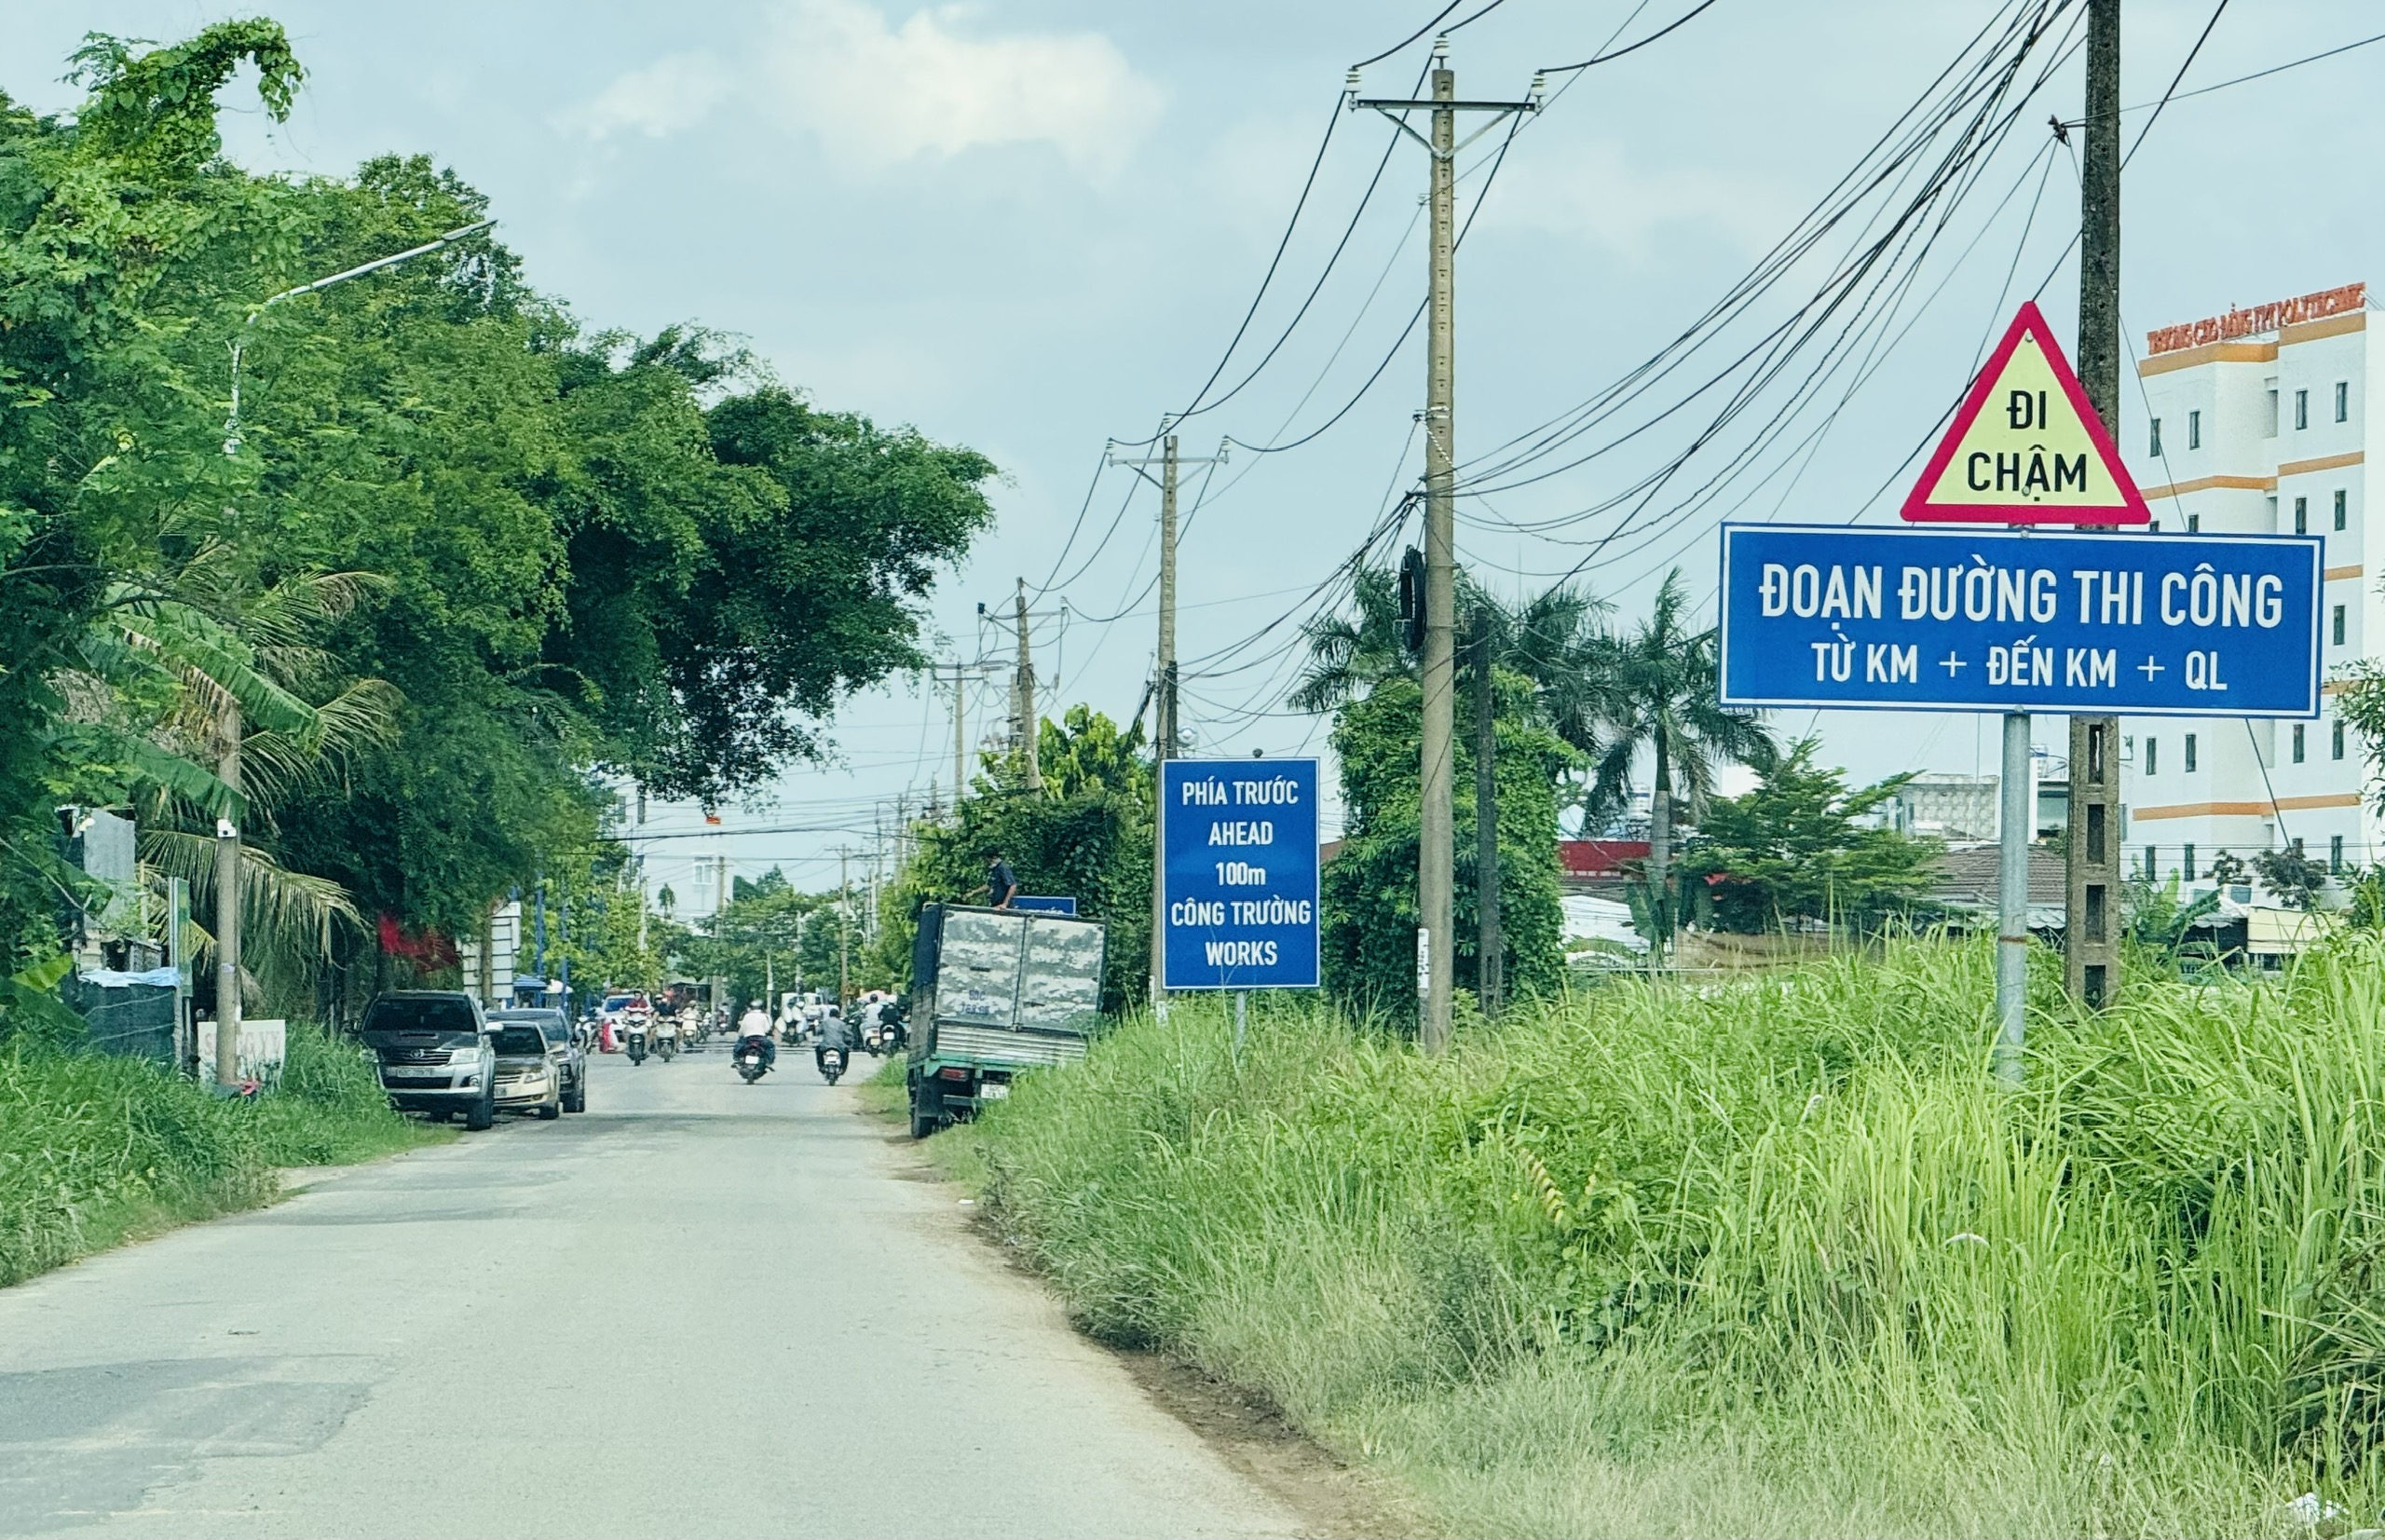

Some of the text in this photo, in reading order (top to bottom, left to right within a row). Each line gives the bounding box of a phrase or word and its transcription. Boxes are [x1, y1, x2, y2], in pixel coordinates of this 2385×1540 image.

[2007, 390, 2046, 429] ĐI
[1969, 444, 2086, 501] CHẬM
[1759, 554, 2282, 630] ĐOẠN ĐƯỜNG THI CÔNG
[1812, 633, 1856, 681] TỪ
[1867, 645, 1916, 683] KM
[1986, 635, 2052, 686] ĐẾN
[2066, 648, 2116, 687] KM
[2186, 651, 2227, 689] QL
[1182, 775, 1299, 805] PHÍA TRƯỚC
[1208, 822, 1273, 845] AHEAD
[1216, 863, 1265, 885] 100m
[1172, 895, 1310, 925] CÔNG TRƯỜNG
[1206, 941, 1277, 965] WORKS
